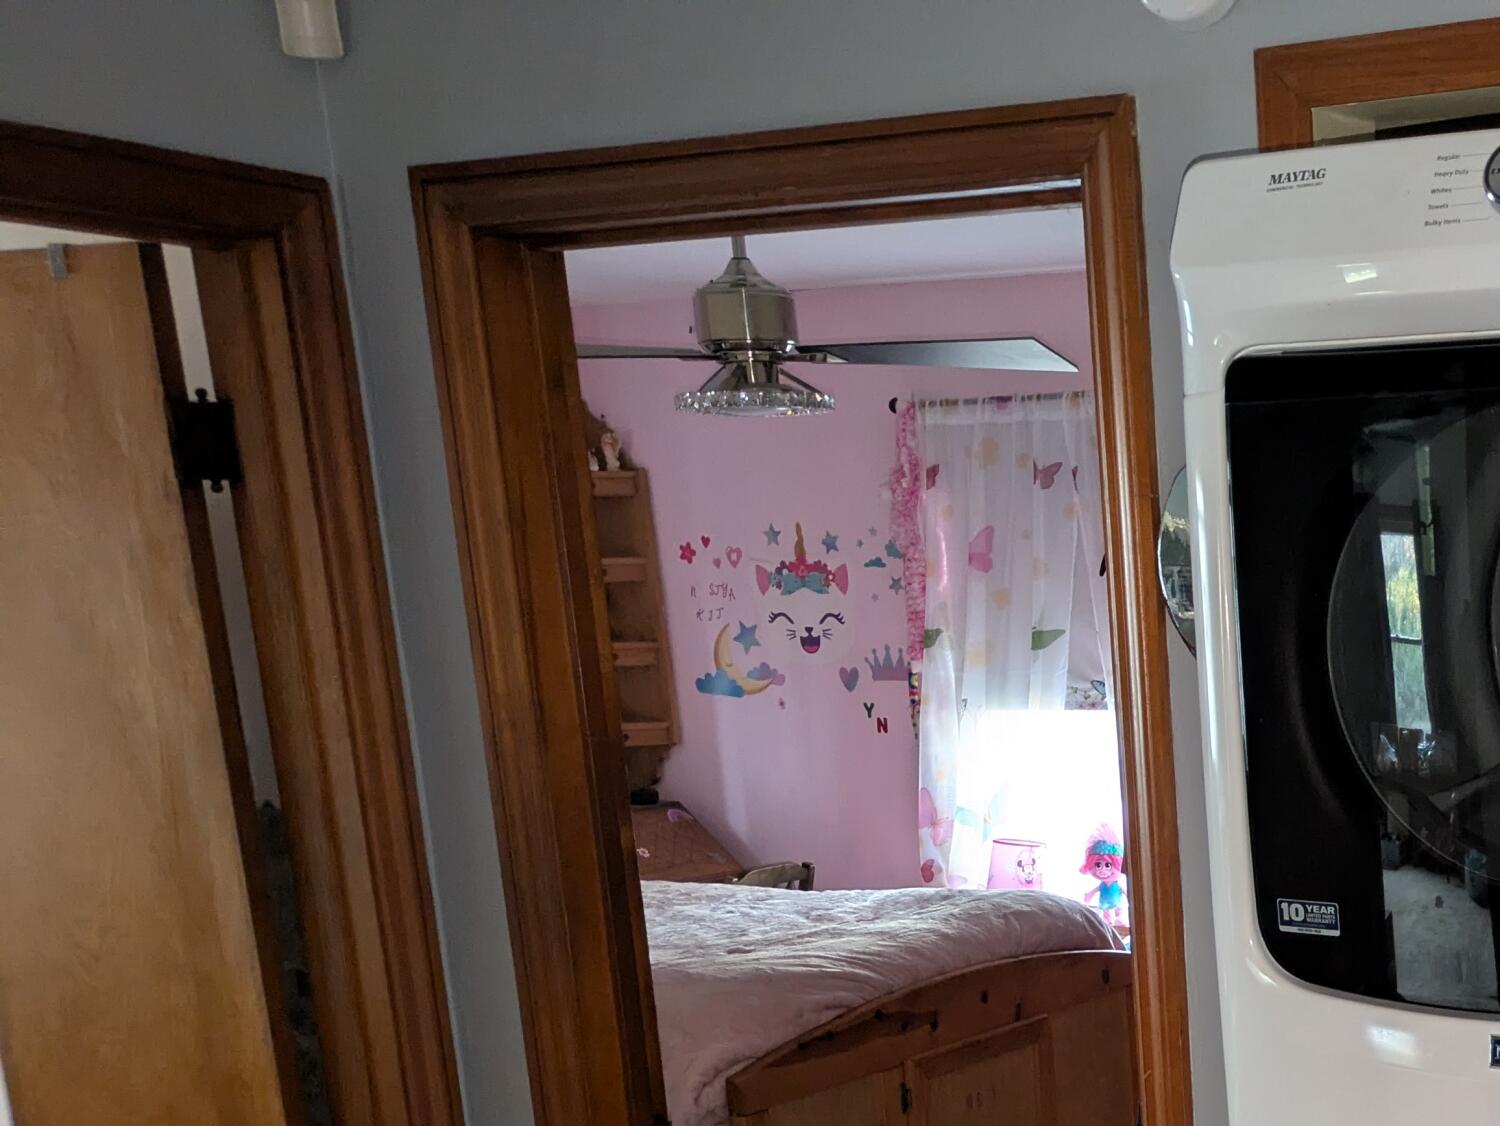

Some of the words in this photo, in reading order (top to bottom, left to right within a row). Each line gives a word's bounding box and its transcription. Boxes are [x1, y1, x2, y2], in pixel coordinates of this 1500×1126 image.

[1268, 168, 1326, 186] MAYTAG
[1424, 219, 1442, 227] Bulky
[863, 702, 875, 718] Y
[876, 717, 888, 733] N
[1281, 902, 1305, 921] 10
[1305, 904, 1335, 914] YEAR
